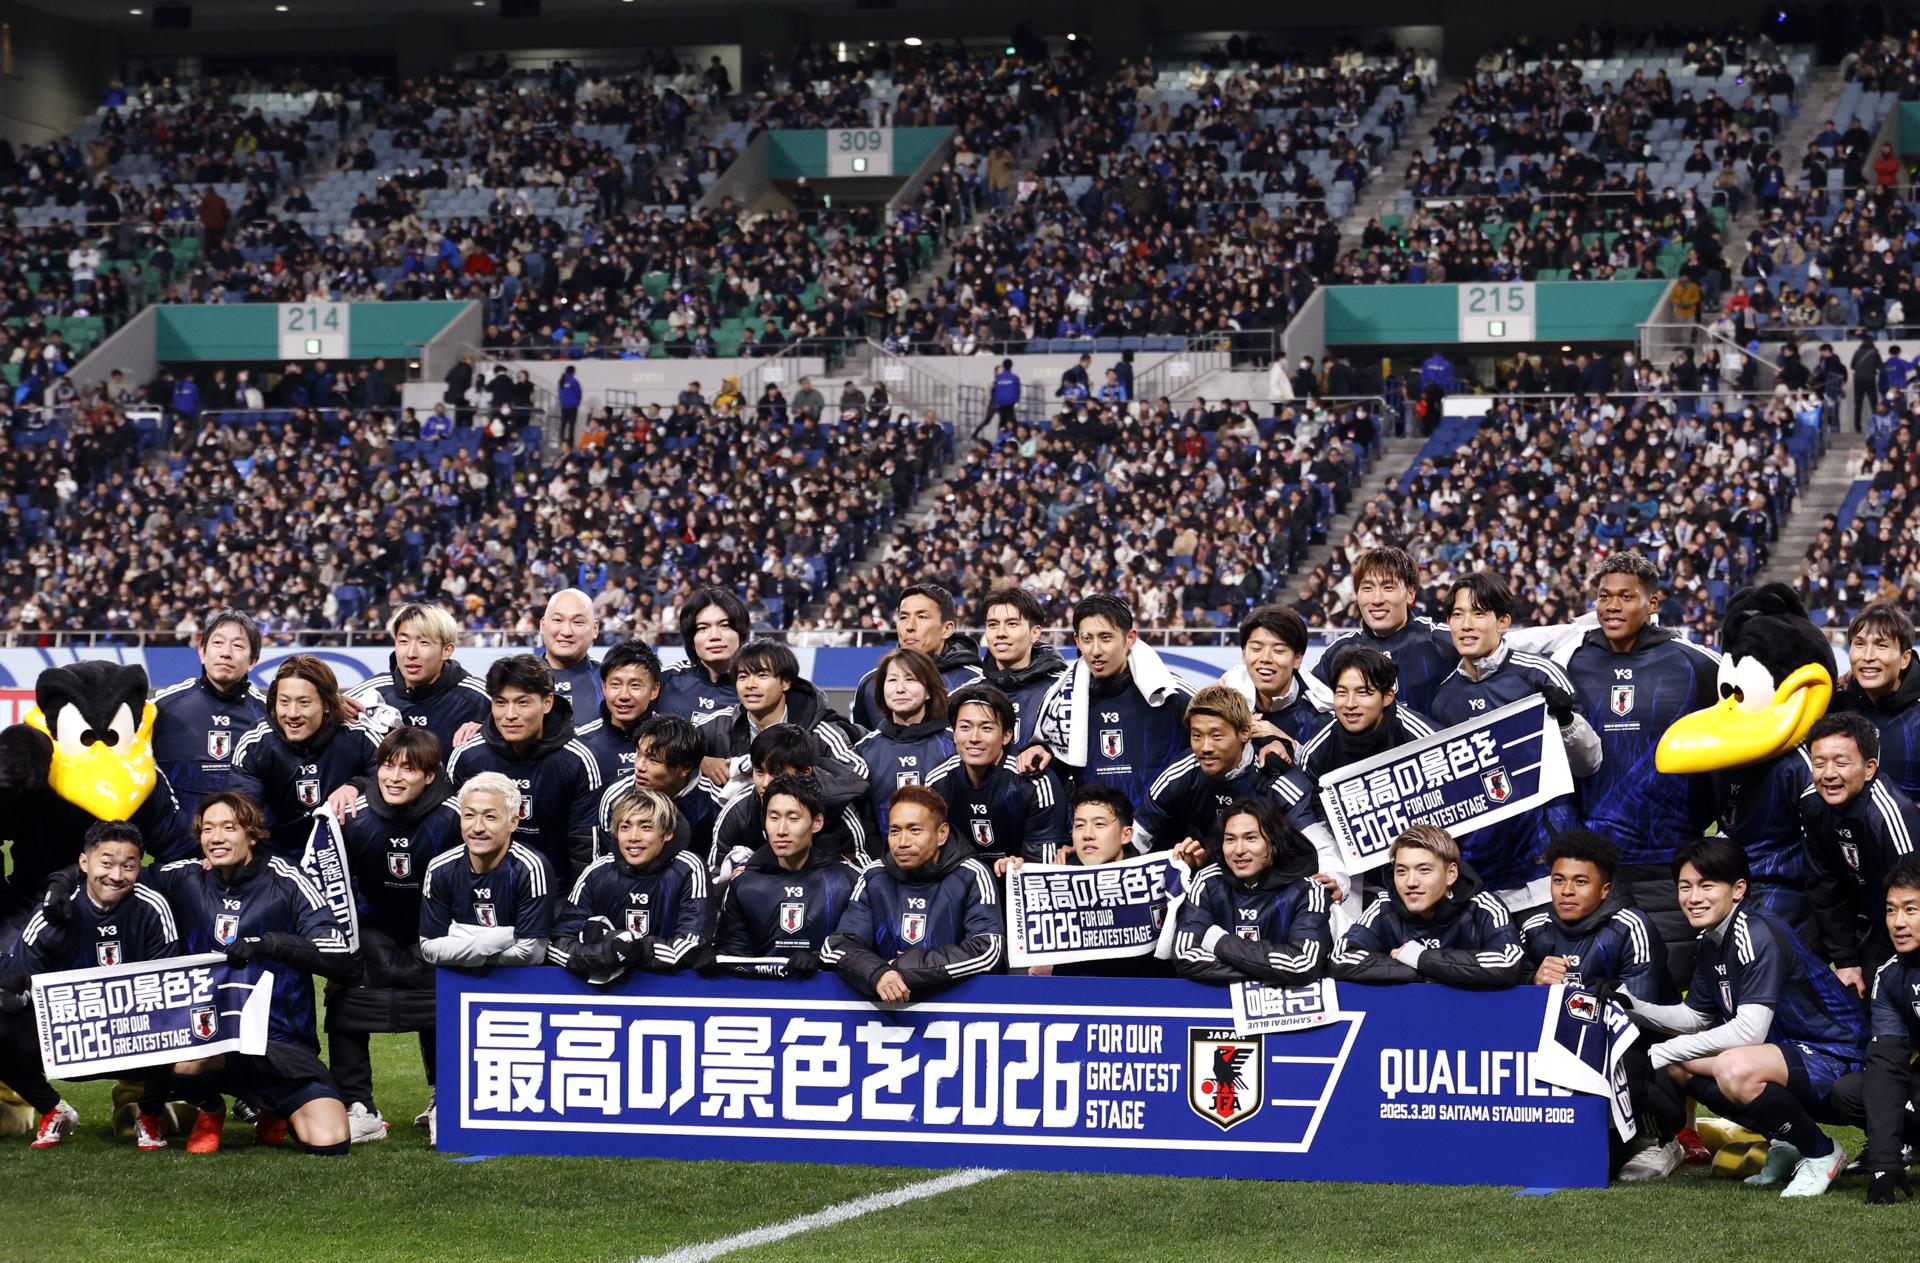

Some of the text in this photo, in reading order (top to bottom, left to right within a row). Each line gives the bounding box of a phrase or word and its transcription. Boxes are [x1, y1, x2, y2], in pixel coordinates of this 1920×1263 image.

[839, 131, 881, 151] 309
[1469, 287, 1524, 312] 215
[288, 307, 338, 331] 214
[1614, 669, 1632, 679] Y-3
[698, 697, 715, 709] Y-3
[1468, 699, 1486, 710] Y-3
[212, 715, 230, 726] Y-3
[409, 716, 428, 726] Y-3
[1101, 712, 1119, 723] Y-3
[300, 764, 317, 775] Y-3
[898, 756, 917, 767] Y-3
[1339, 730, 1500, 818] 最高の景色を
[970, 803, 988, 814] Y-3
[1404, 789, 1444, 816] FOR OUR
[1459, 793, 1489, 820] STAGE
[1324, 785, 1354, 846] SAMURAI BLUE
[389, 838, 409, 848] Y-3
[473, 889, 491, 899] Y-3
[784, 887, 803, 897] Y-3
[1024, 864, 1168, 913] 最高の景色を
[222, 898, 241, 910] Y-3
[630, 893, 648, 904] Y-3
[907, 898, 926, 909] Y-3
[1012, 873, 1024, 940] SAMURAI BLUE
[1080, 909, 1114, 928] FOR OUR
[1238, 909, 1258, 920] Y-3
[97, 925, 118, 936] Y-3
[1027, 912, 1081, 951] 2026
[1083, 924, 1153, 948] GREATEST STAGE
[47, 967, 213, 1025] 最高の景色を
[35, 986, 51, 1053] SAMURAI BLUE
[110, 1015, 150, 1036] FOR OUR
[1247, 1016, 1312, 1030] SAMURAI BLUE
[53, 1019, 111, 1064] 2026
[113, 1029, 192, 1056] GREATEST STAGE
[1087, 1024, 1163, 1054] FOR OUR
[1207, 1031, 1245, 1040] JAPA
[1086, 1062, 1181, 1093] GREATEST
[1209, 1096, 1242, 1111] JFA
[1085, 1100, 1145, 1130] STAGE
[1380, 1104, 1575, 1124] 2025.3.20 SAITAMA STADIUM 2002
